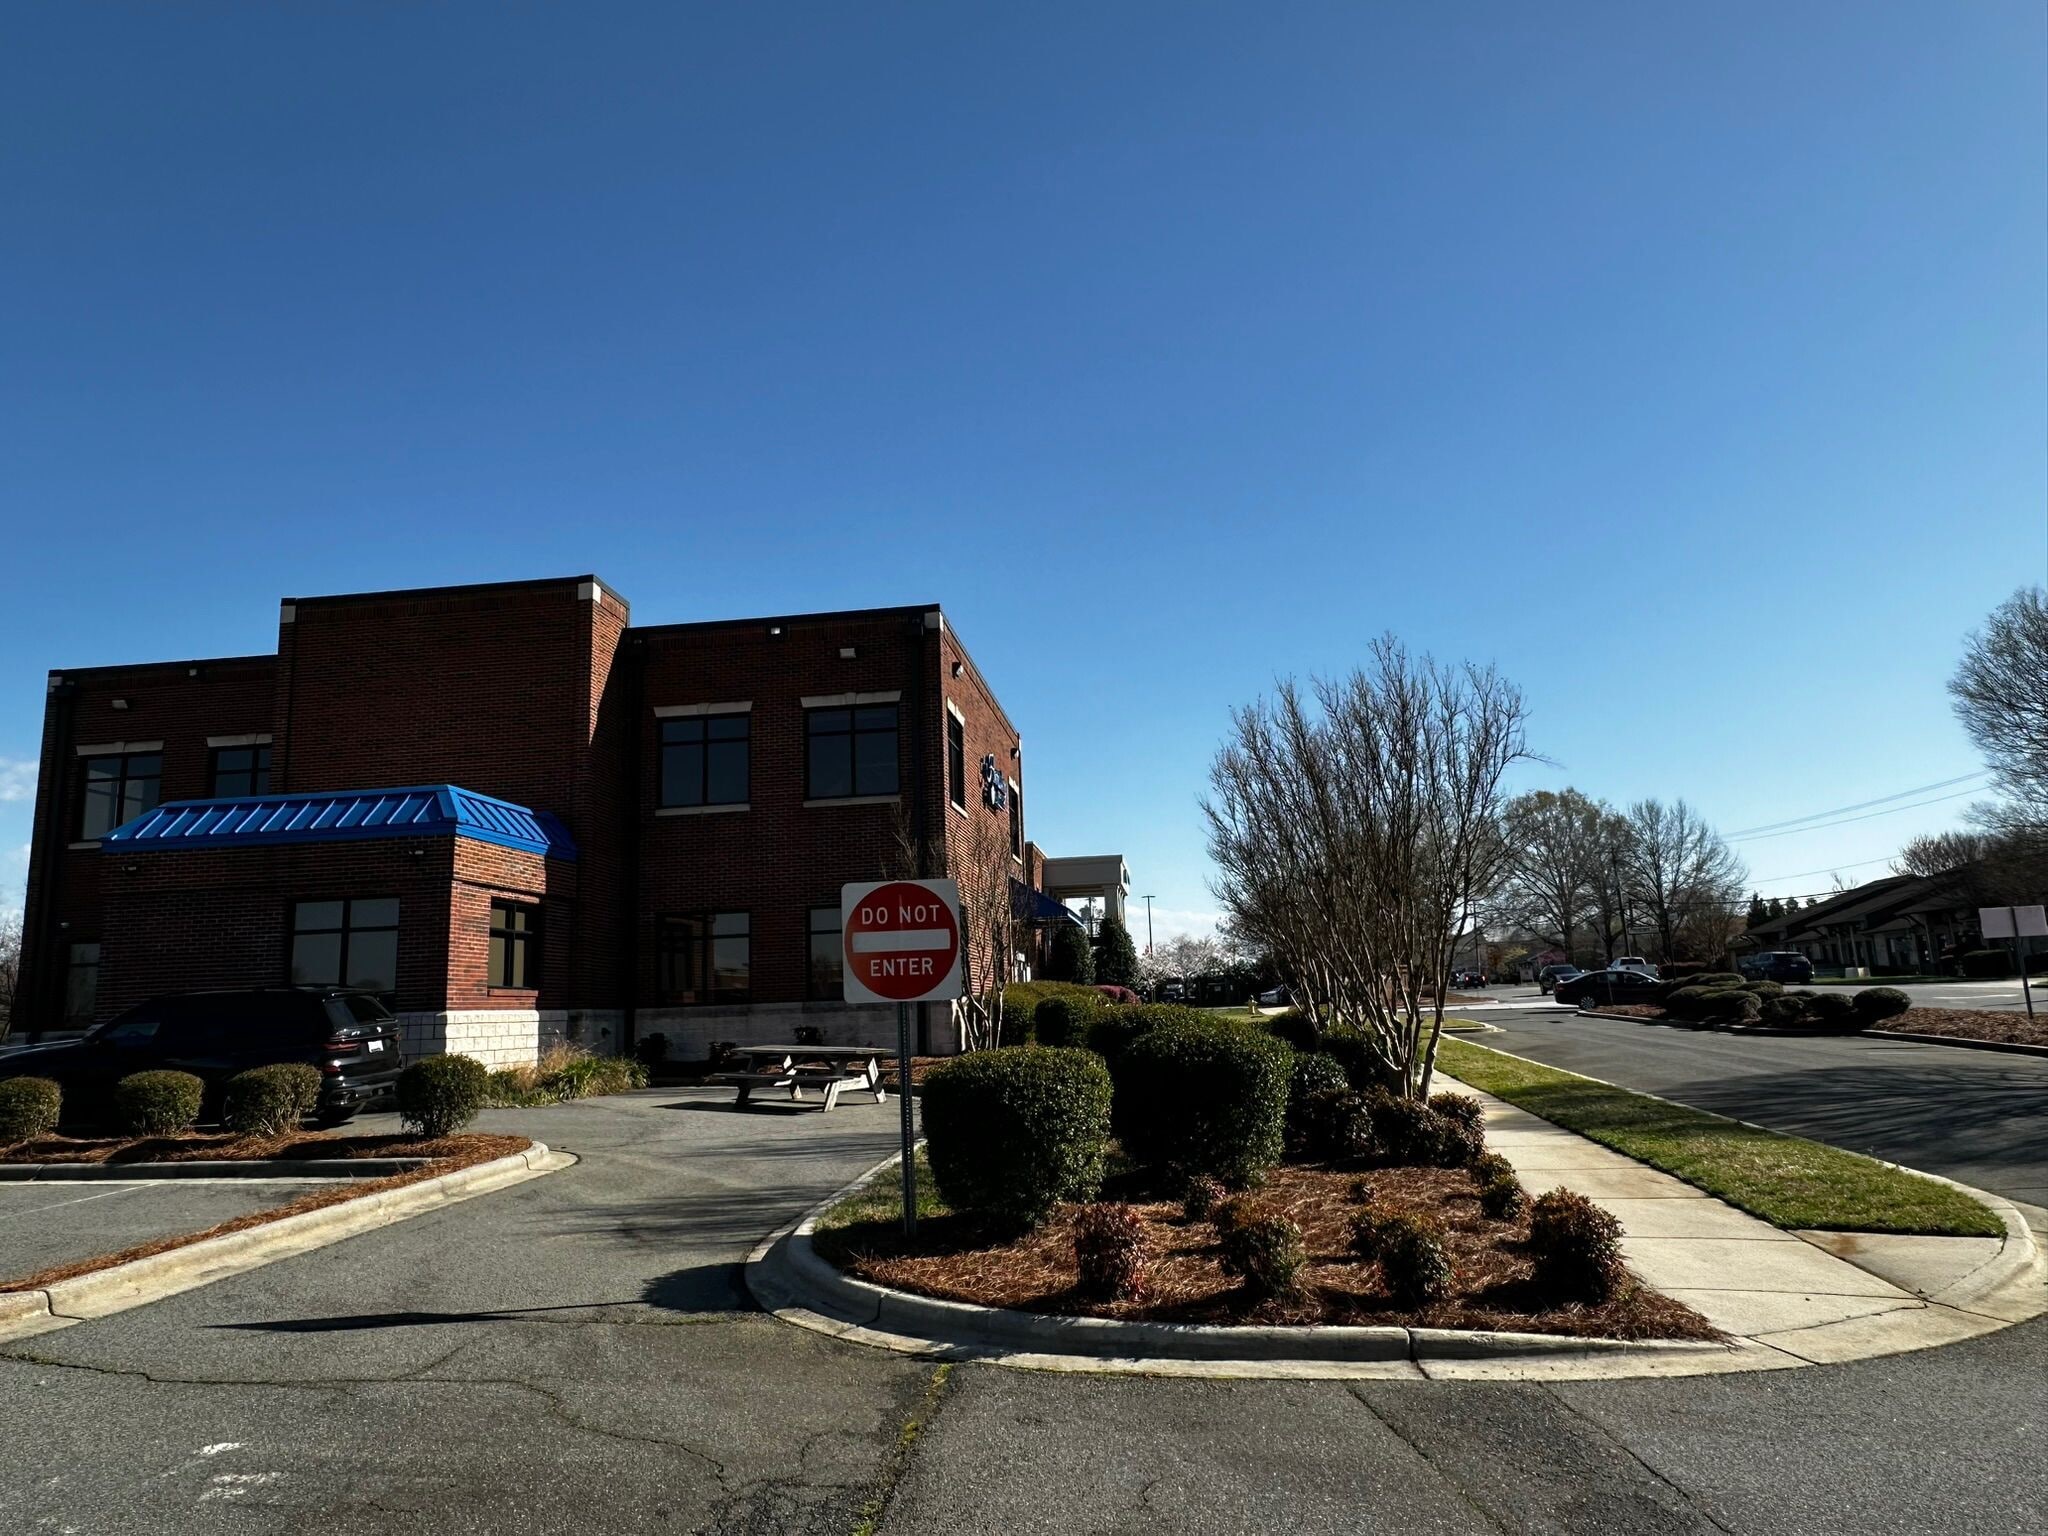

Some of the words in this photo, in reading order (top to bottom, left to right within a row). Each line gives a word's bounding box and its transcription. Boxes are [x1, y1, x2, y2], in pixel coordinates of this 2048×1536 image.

[862, 907, 888, 925] DO
[899, 905, 940, 924] NOT
[870, 957, 933, 977] ENTER
